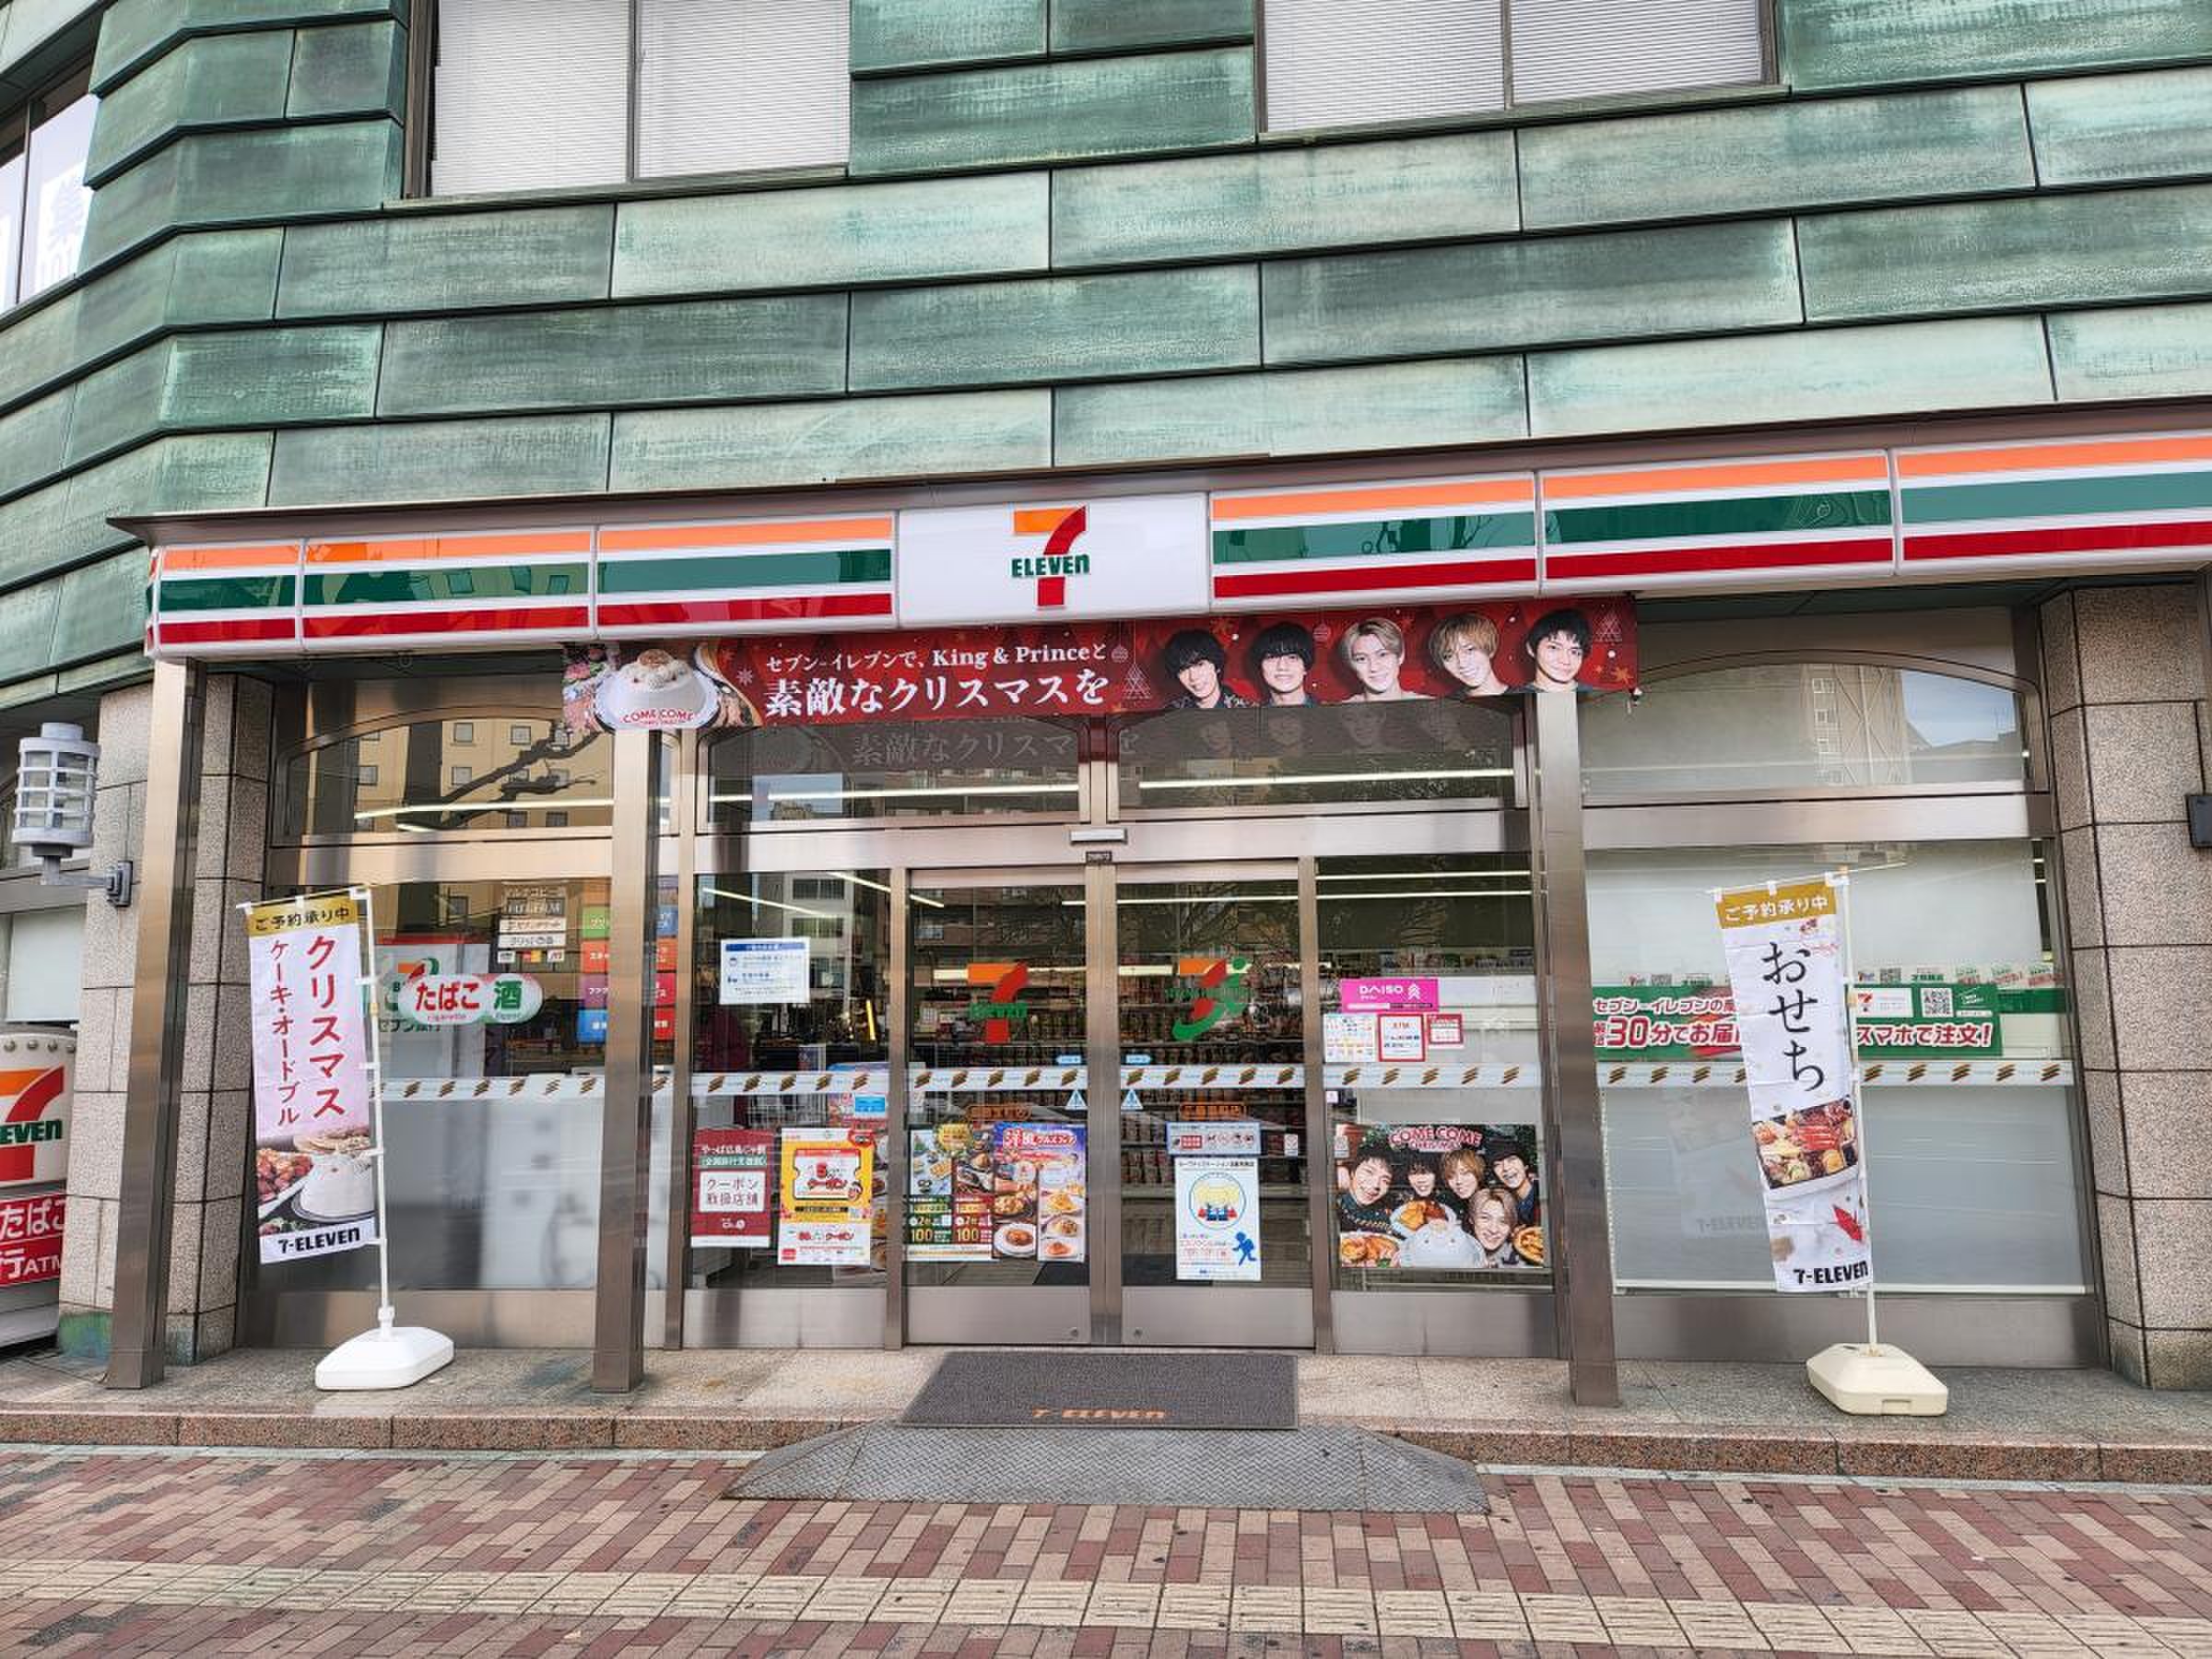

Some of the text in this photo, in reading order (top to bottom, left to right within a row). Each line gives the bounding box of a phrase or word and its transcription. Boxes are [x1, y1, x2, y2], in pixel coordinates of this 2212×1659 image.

[932, 649, 988, 669] King
[994, 648, 1009, 665] &
[765, 668, 1109, 718] 素敵なクリスマスを
[622, 710, 657, 724] COME
[659, 709, 694, 722] COME
[255, 906, 350, 931] ご予約承り中
[1724, 894, 1828, 922] ご予約承り中
[415, 981, 524, 1011] たばこ 酒
[1359, 985, 1403, 994] DAISO
[306, 935, 346, 1118] クリスマス
[1761, 942, 1825, 1091] おせち
[269, 939, 300, 1126] ケーキ・オードブル
[708, 1178, 759, 1192] クーポン
[278, 1227, 360, 1253] 7-ELEVEN
[912, 1229, 933, 1242] 100
[1794, 1261, 1868, 1285] 7-ELEVEN
